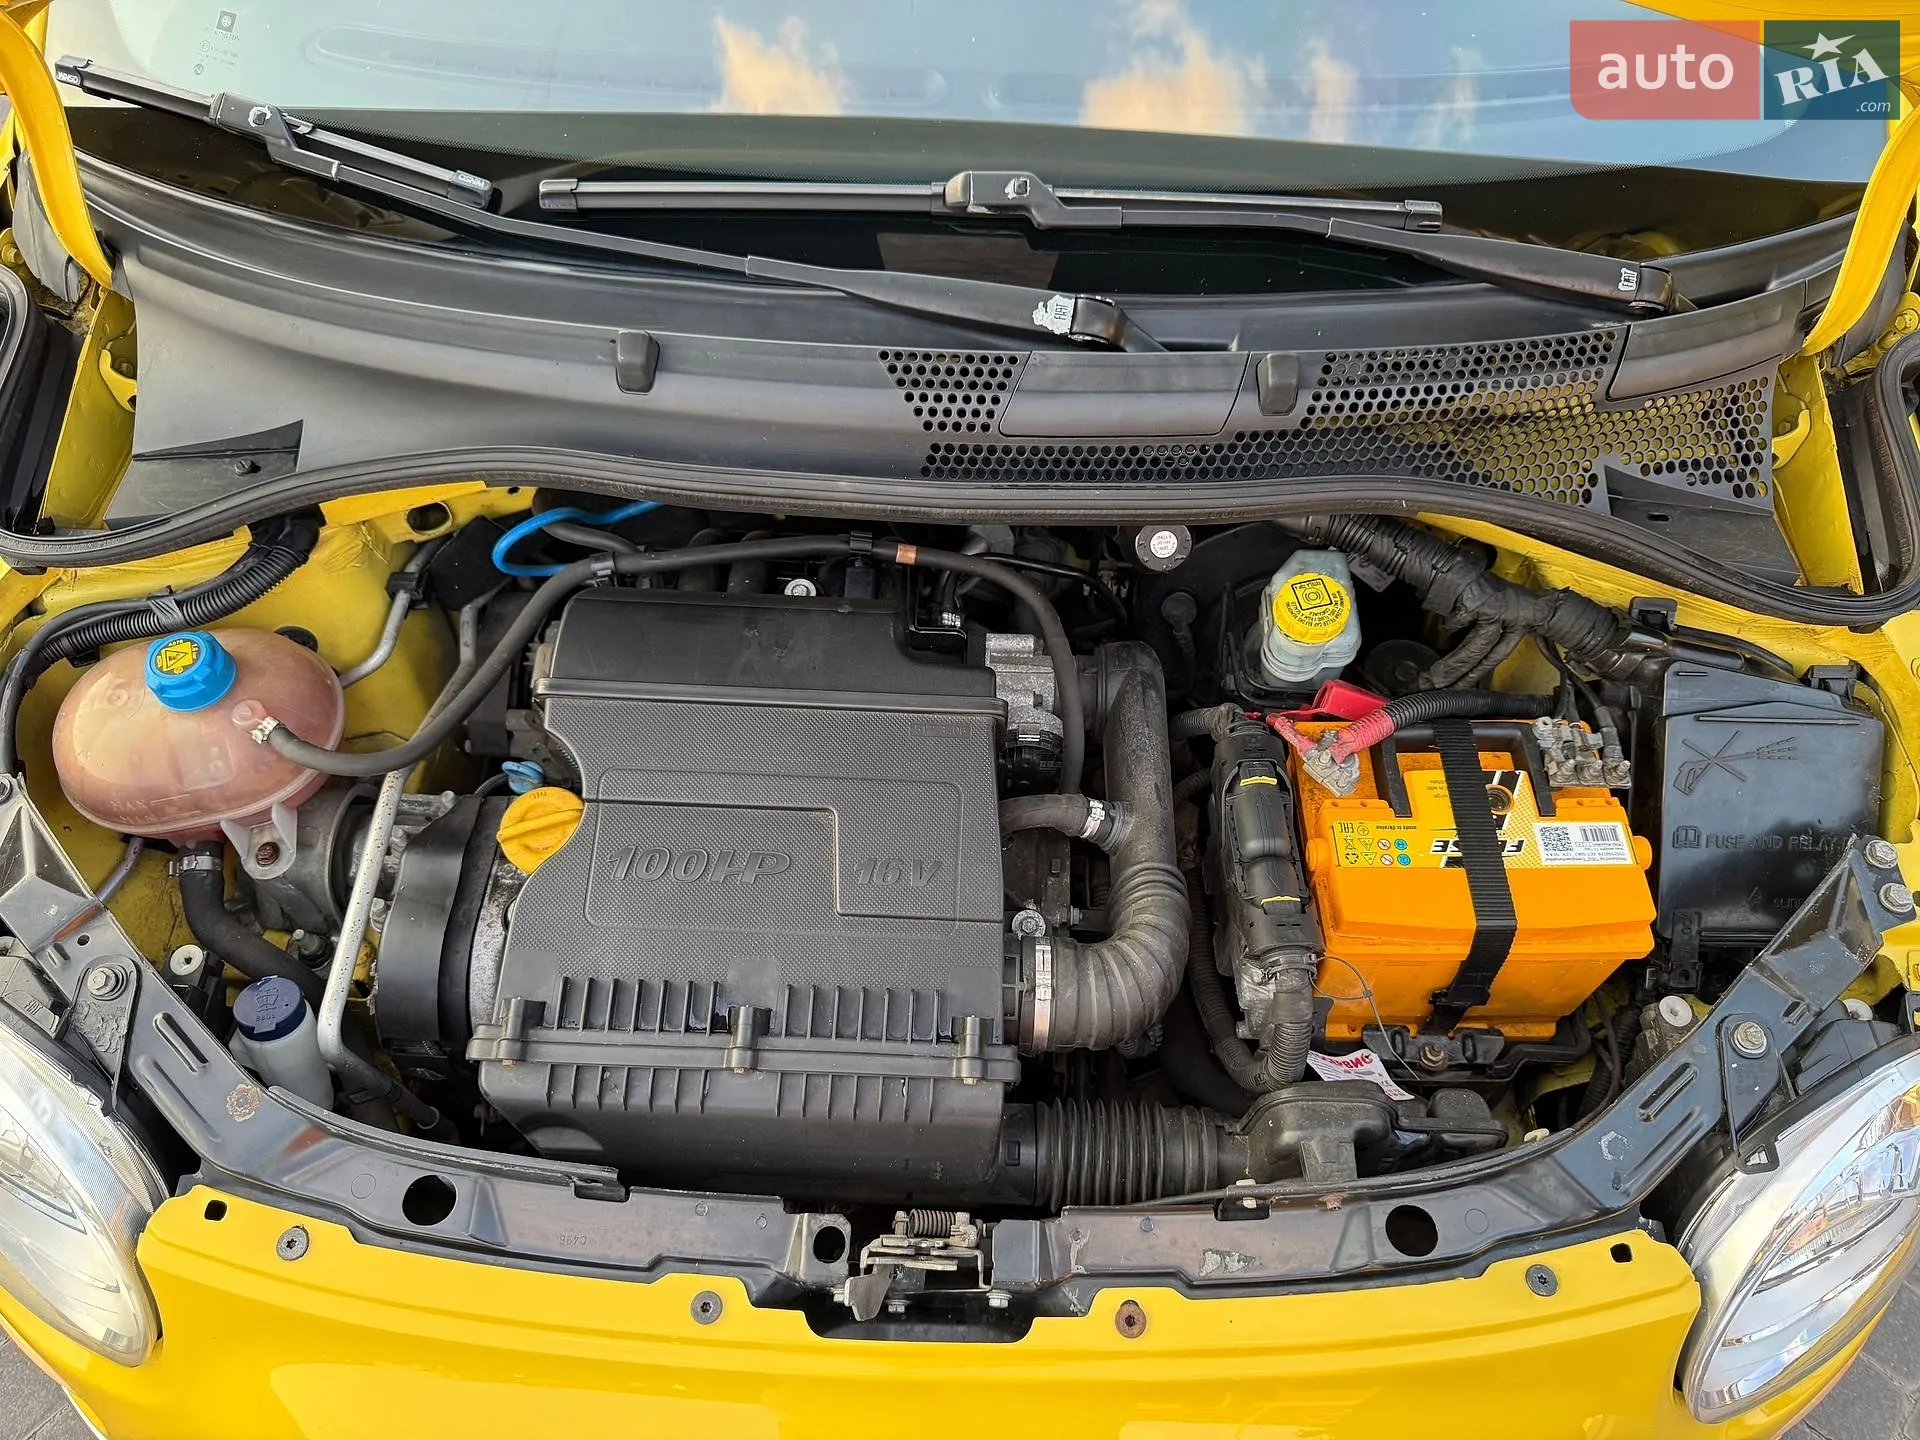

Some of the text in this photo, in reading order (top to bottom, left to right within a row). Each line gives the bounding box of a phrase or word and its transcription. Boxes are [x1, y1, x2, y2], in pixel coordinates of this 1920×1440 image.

[1053, 302, 1070, 322] FIAT
[1706, 834, 1745, 850] FUSE
[1752, 834, 1784, 851] AND
[607, 846, 790, 885] 100HP
